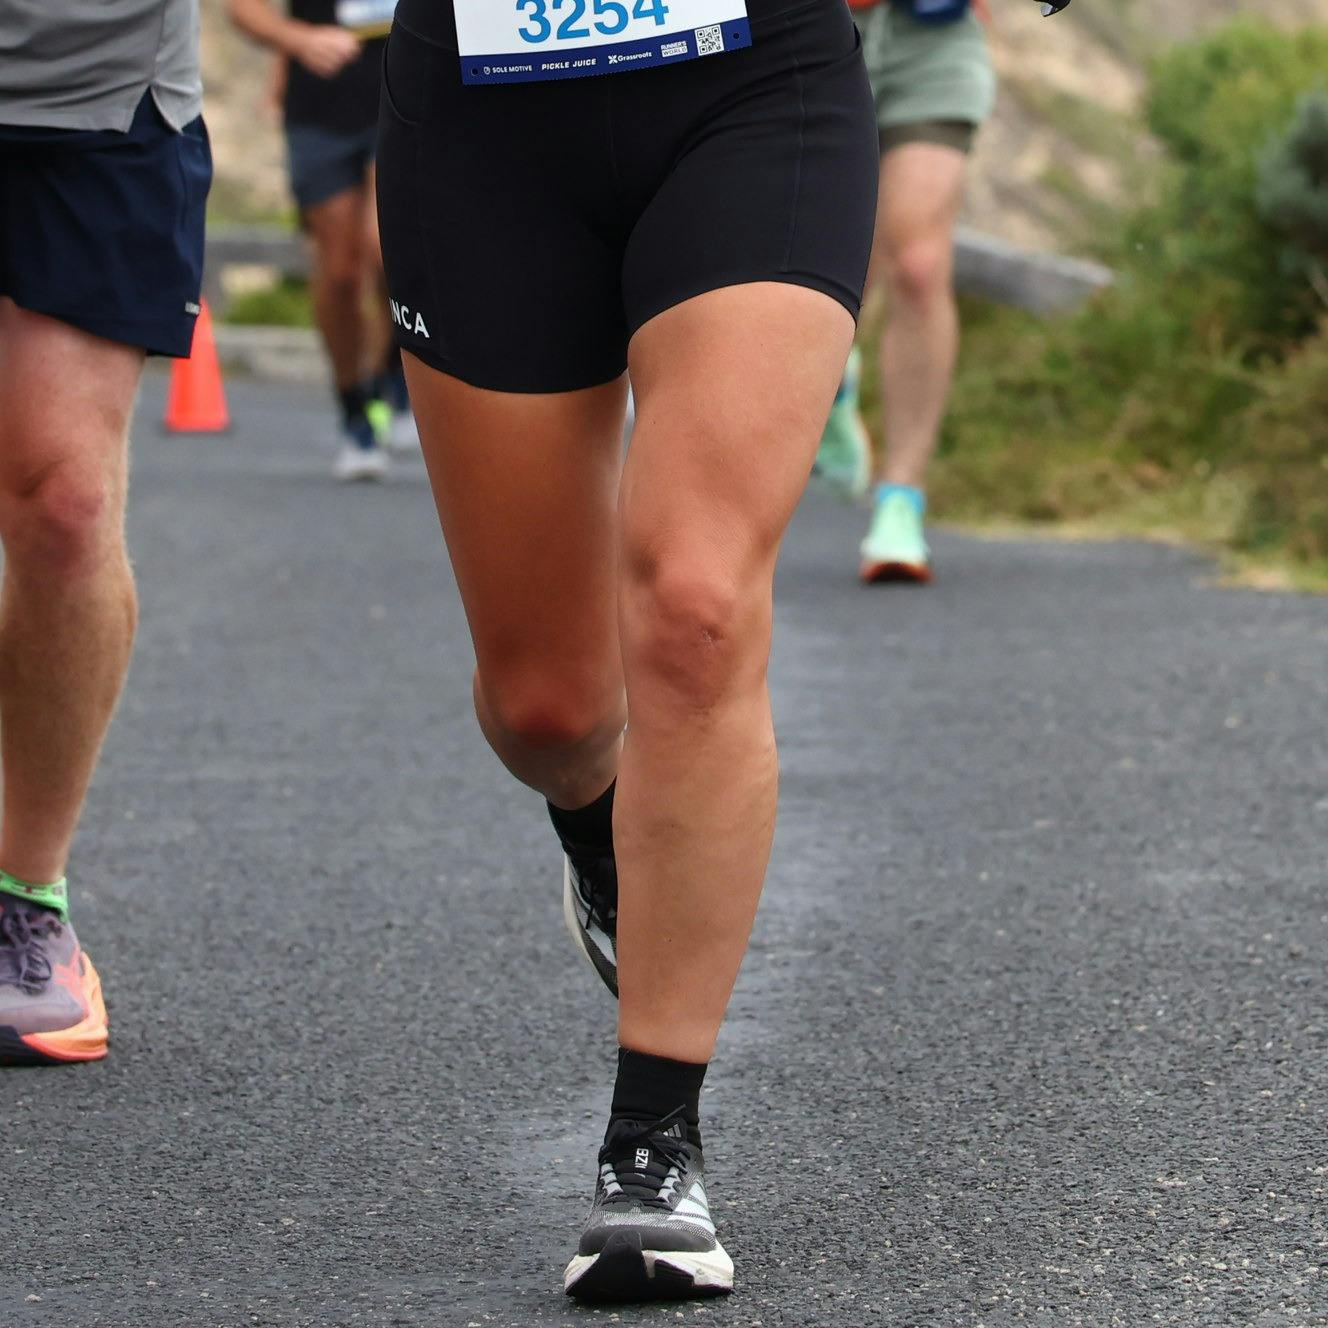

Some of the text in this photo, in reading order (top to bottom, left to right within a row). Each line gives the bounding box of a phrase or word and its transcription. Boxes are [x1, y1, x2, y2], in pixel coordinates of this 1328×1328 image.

[617, 51, 653, 62] Grassroots
[492, 65, 533, 74] SOLE MOTIVE
[541, 58, 597, 71] PICKLE JUICE
